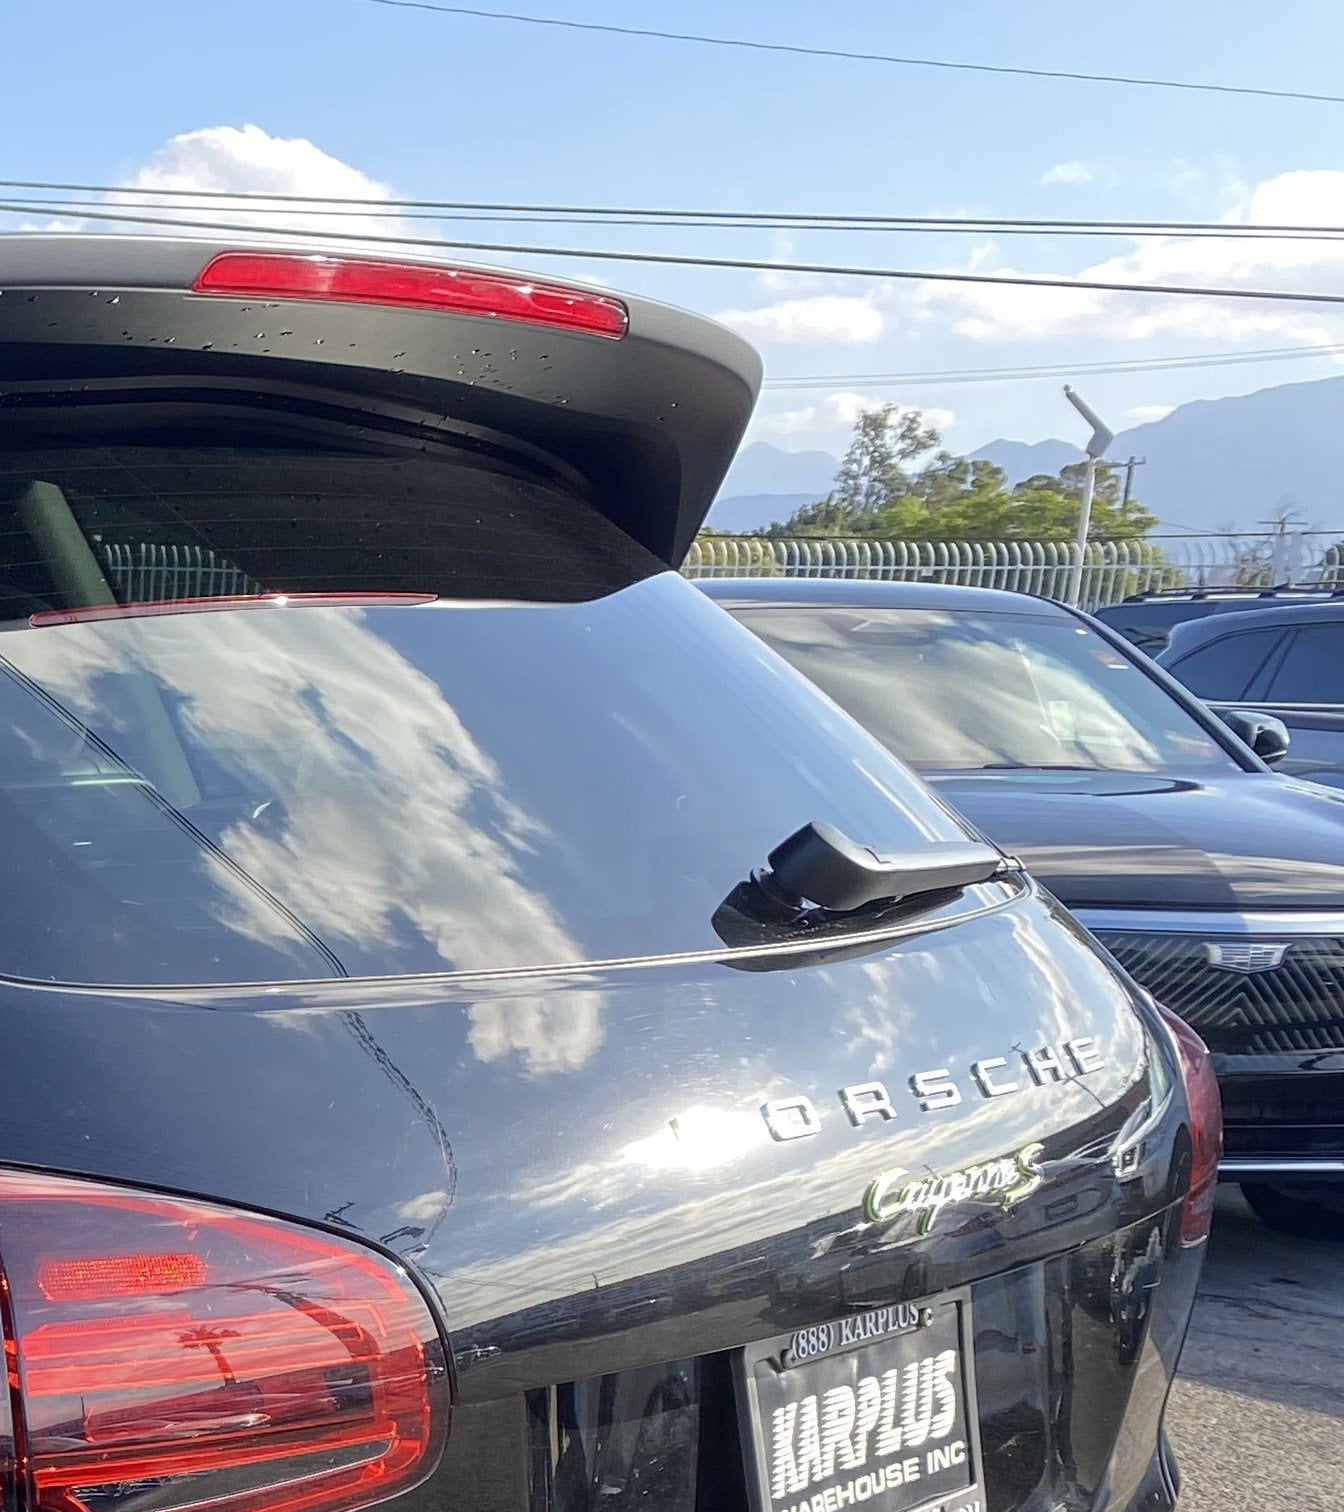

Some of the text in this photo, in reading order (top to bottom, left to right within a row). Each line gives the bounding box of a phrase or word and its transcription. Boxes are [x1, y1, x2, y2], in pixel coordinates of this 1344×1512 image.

[666, 1036, 1106, 1142] ORSCHE
[790, 1303, 920, 1361] (888) KARPLUS
[771, 1349, 957, 1499] KARPLUS
[926, 1439, 967, 1476] INC
